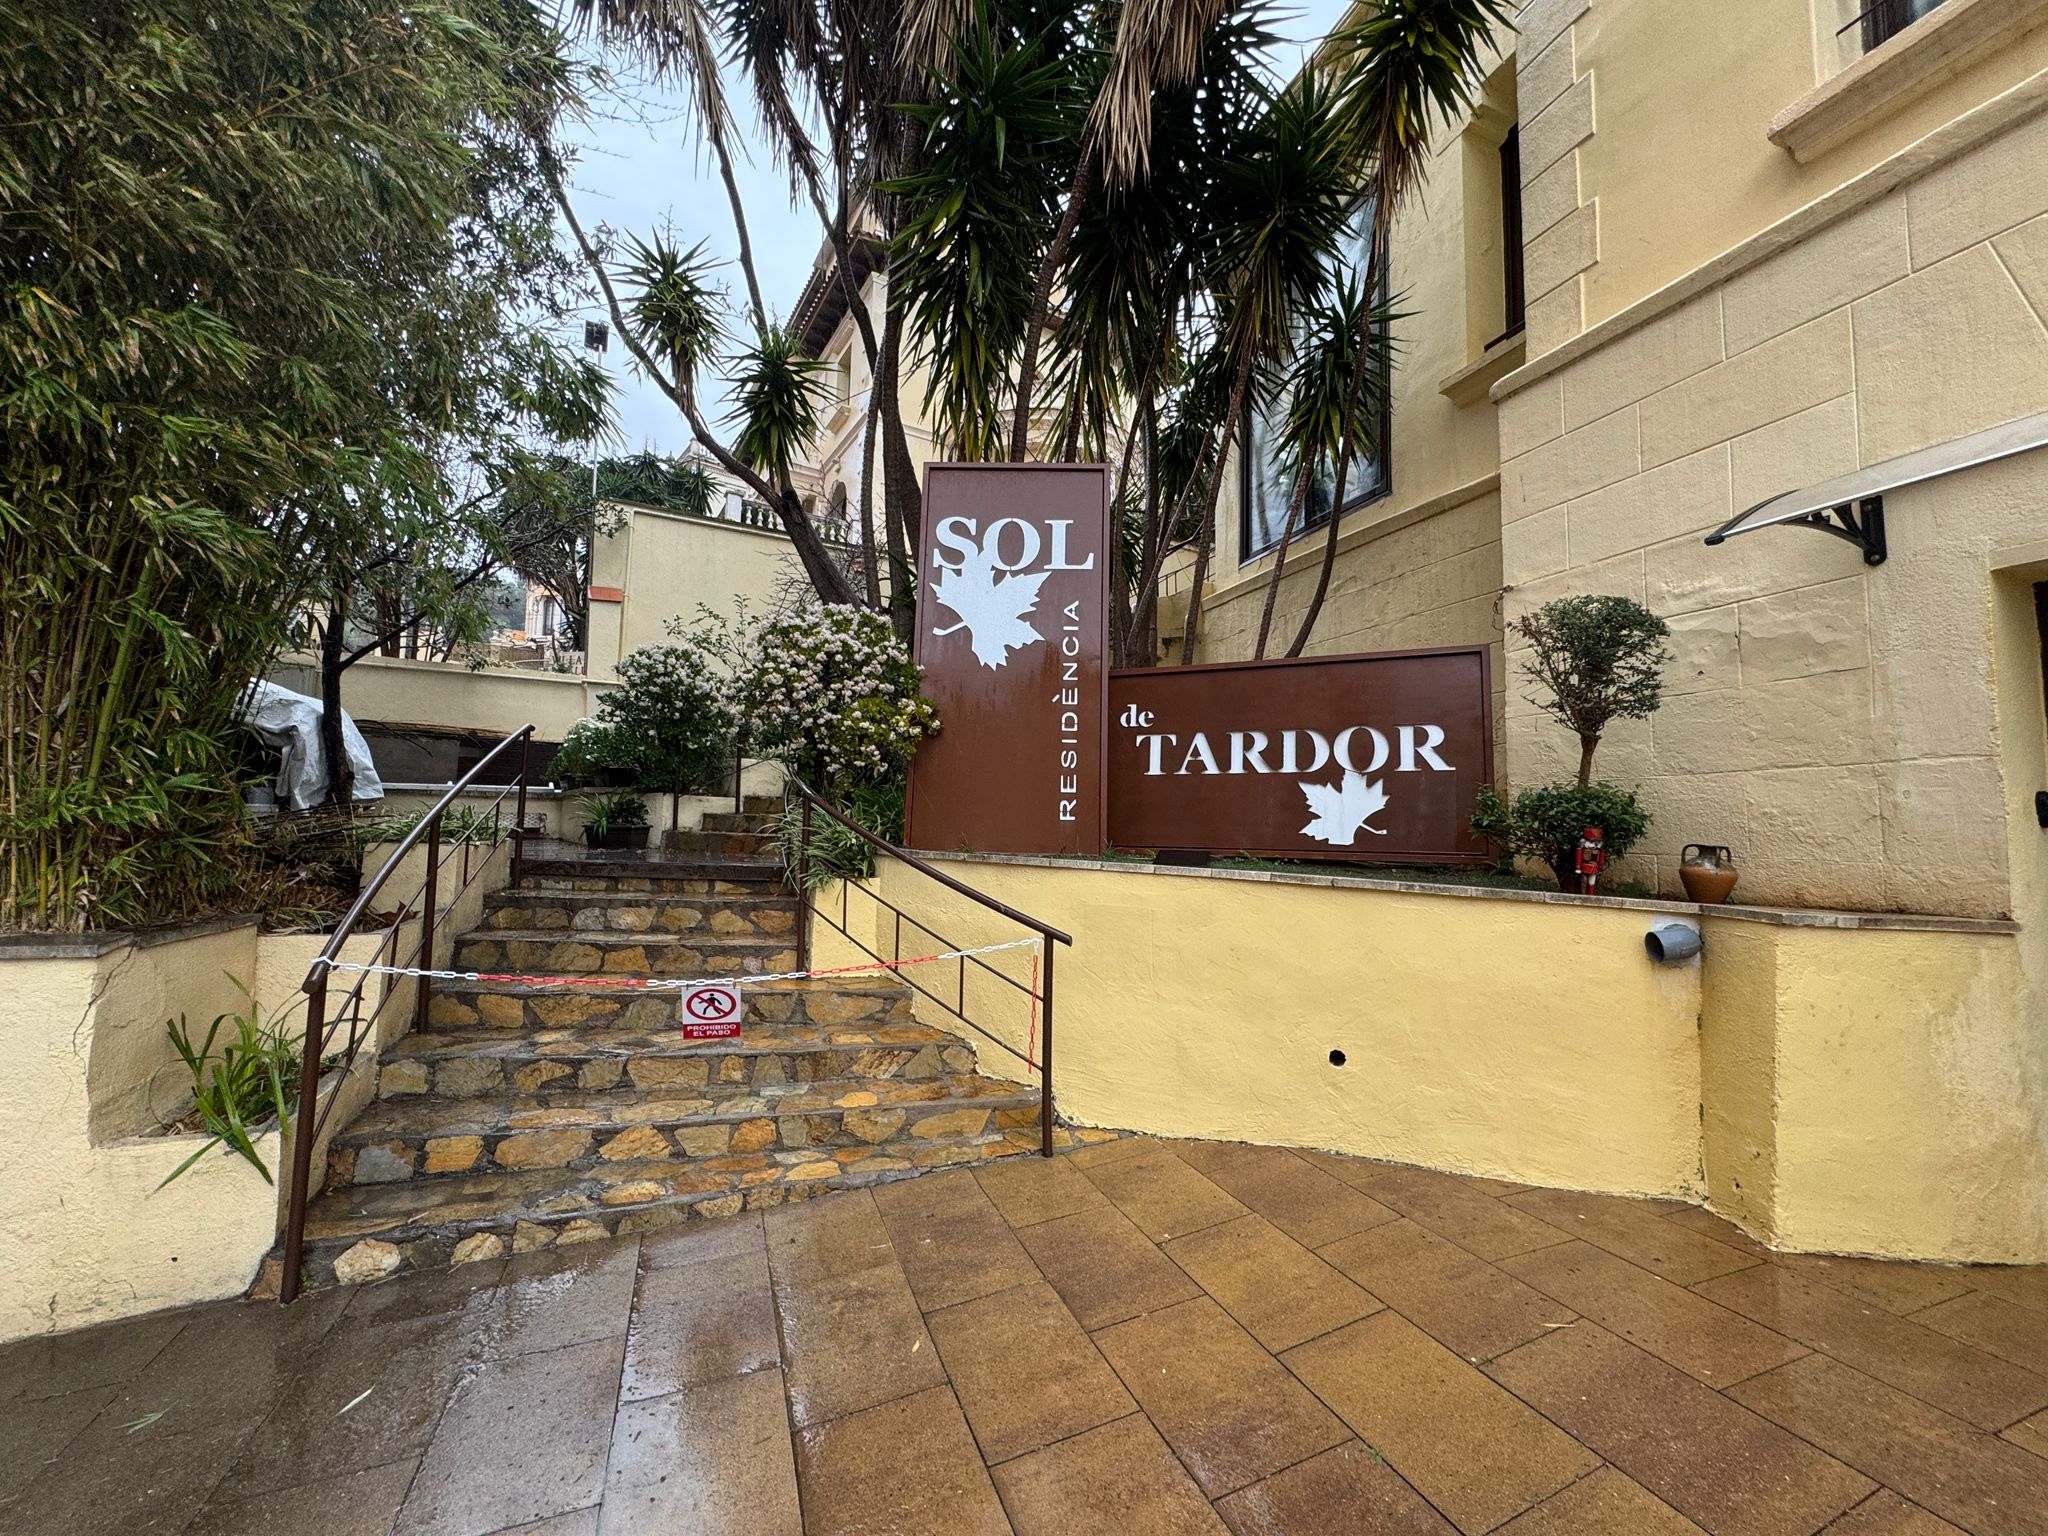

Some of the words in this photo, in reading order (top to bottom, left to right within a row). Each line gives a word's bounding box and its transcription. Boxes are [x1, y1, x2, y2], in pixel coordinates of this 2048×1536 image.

[932, 515, 1095, 572] SOL
[1051, 599, 1080, 821] RESIDÈNCIA
[1120, 703, 1155, 728] de
[1136, 723, 1456, 776] TARDOR
